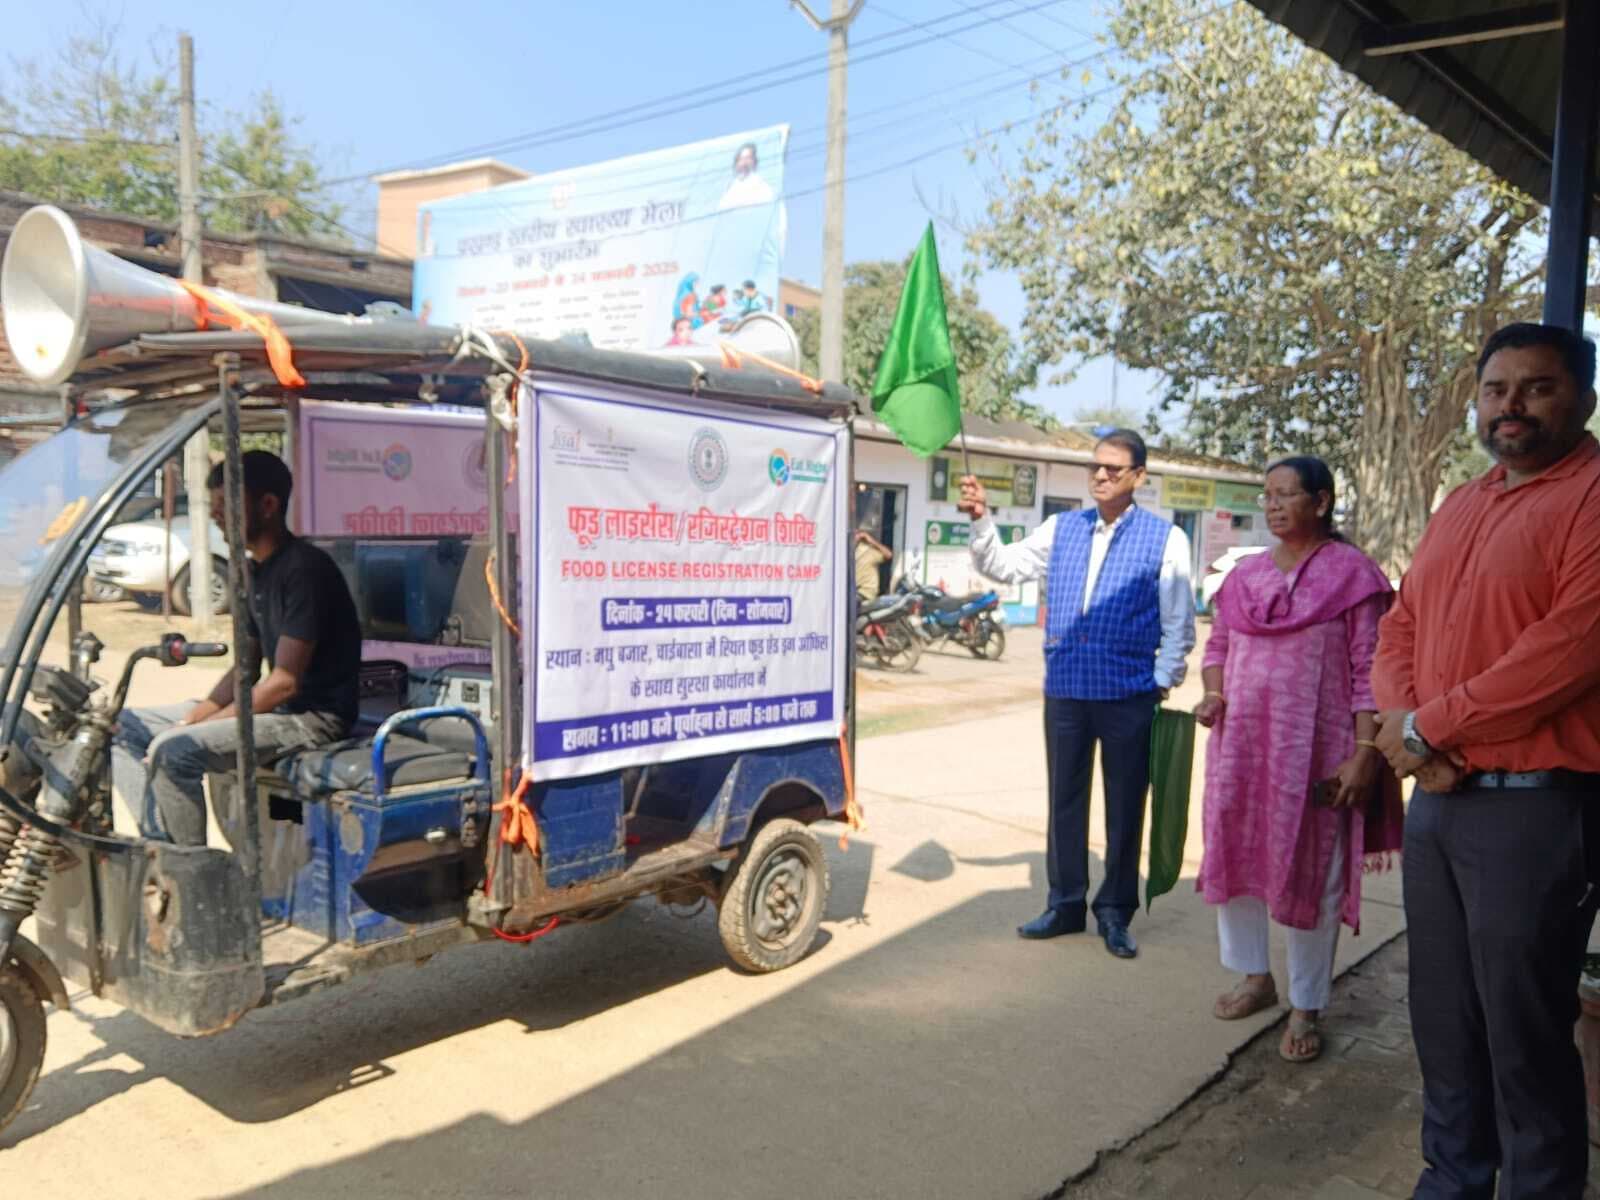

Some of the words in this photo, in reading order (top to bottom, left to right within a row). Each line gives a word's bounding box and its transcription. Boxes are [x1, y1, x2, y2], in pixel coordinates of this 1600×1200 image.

[565, 207, 634, 236] स्वास्थ्य
[641, 198, 688, 225] मेला
[513, 248, 533, 269] का
[642, 261, 680, 277] 2025
[567, 506, 599, 547] फूड
[774, 512, 817, 545] शिविर
[561, 560, 606, 579] FOOD
[611, 561, 677, 580] LICENSE
[682, 562, 783, 581] REGISTRATION
[787, 564, 821, 581] CAMP
[606, 599, 645, 625] दिनांक
[674, 599, 709, 623] फरवरी
[711, 598, 738, 625] (दिन
[746, 598, 789, 624] सोमवार)
[545, 648, 583, 669] स्थान
[656, 638, 702, 661] चाईबासा
[705, 635, 717, 657] में
[720, 635, 746, 657] स्थित
[748, 638, 764, 661] फूड
[766, 634, 780, 655] एंड
[630, 675, 641, 697] के
[677, 675, 710, 700] सुरक्षा
[712, 668, 755, 692] कार्यालय
[758, 666, 767, 686] में
[562, 726, 598, 751] समय
[611, 720, 649, 743] 11:00
[652, 712, 672, 737] बजे
[715, 706, 727, 730] से
[754, 705, 780, 725] 5:00
[782, 698, 798, 720] बजे
[800, 700, 817, 719] तक
